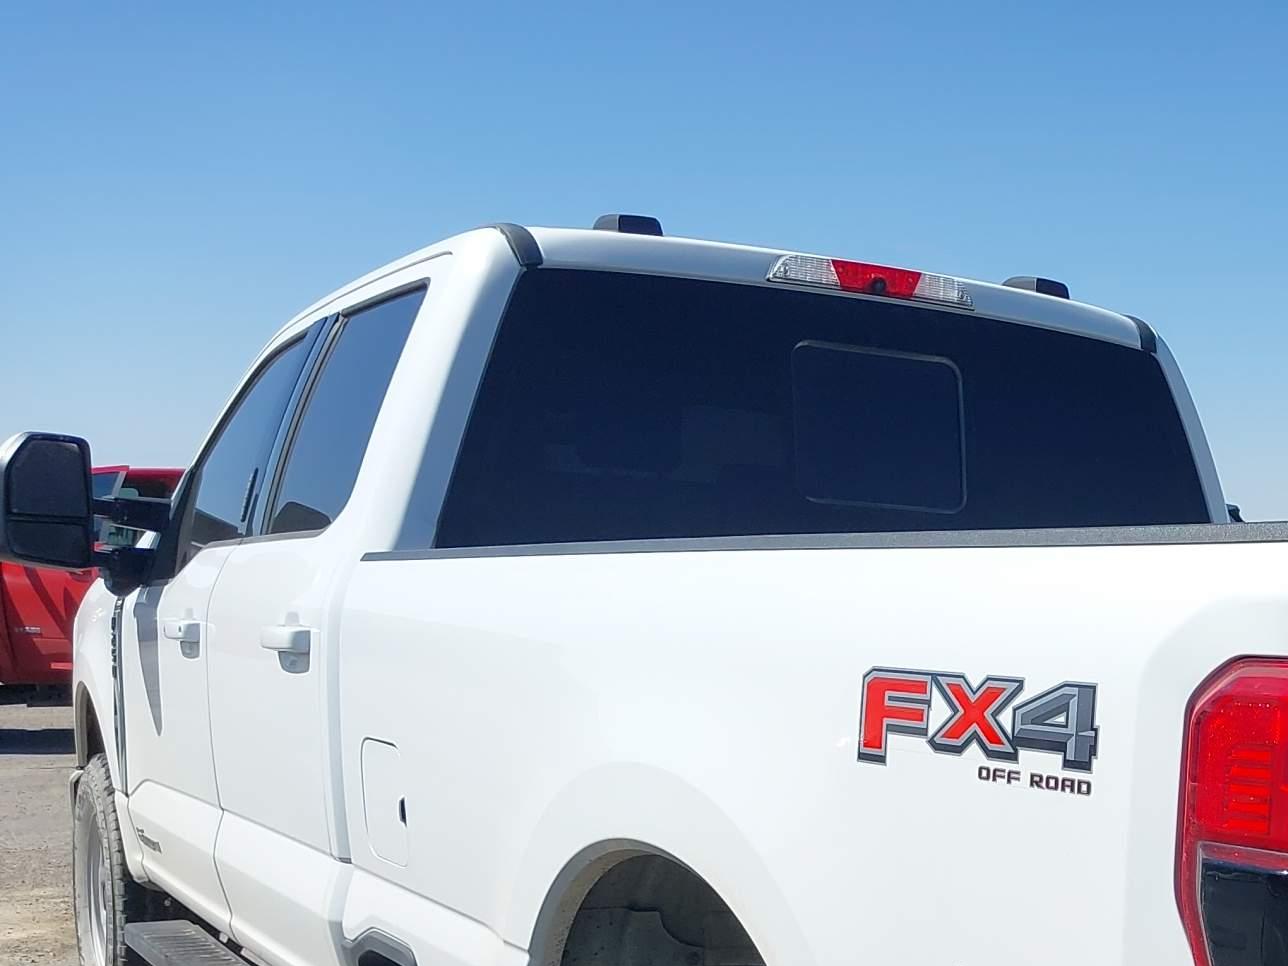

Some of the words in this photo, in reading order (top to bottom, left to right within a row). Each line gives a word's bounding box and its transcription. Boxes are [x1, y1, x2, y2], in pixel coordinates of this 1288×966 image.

[857, 666, 1100, 774] FX4
[977, 765, 1021, 785] OFF
[1029, 772, 1093, 797] ROAD
